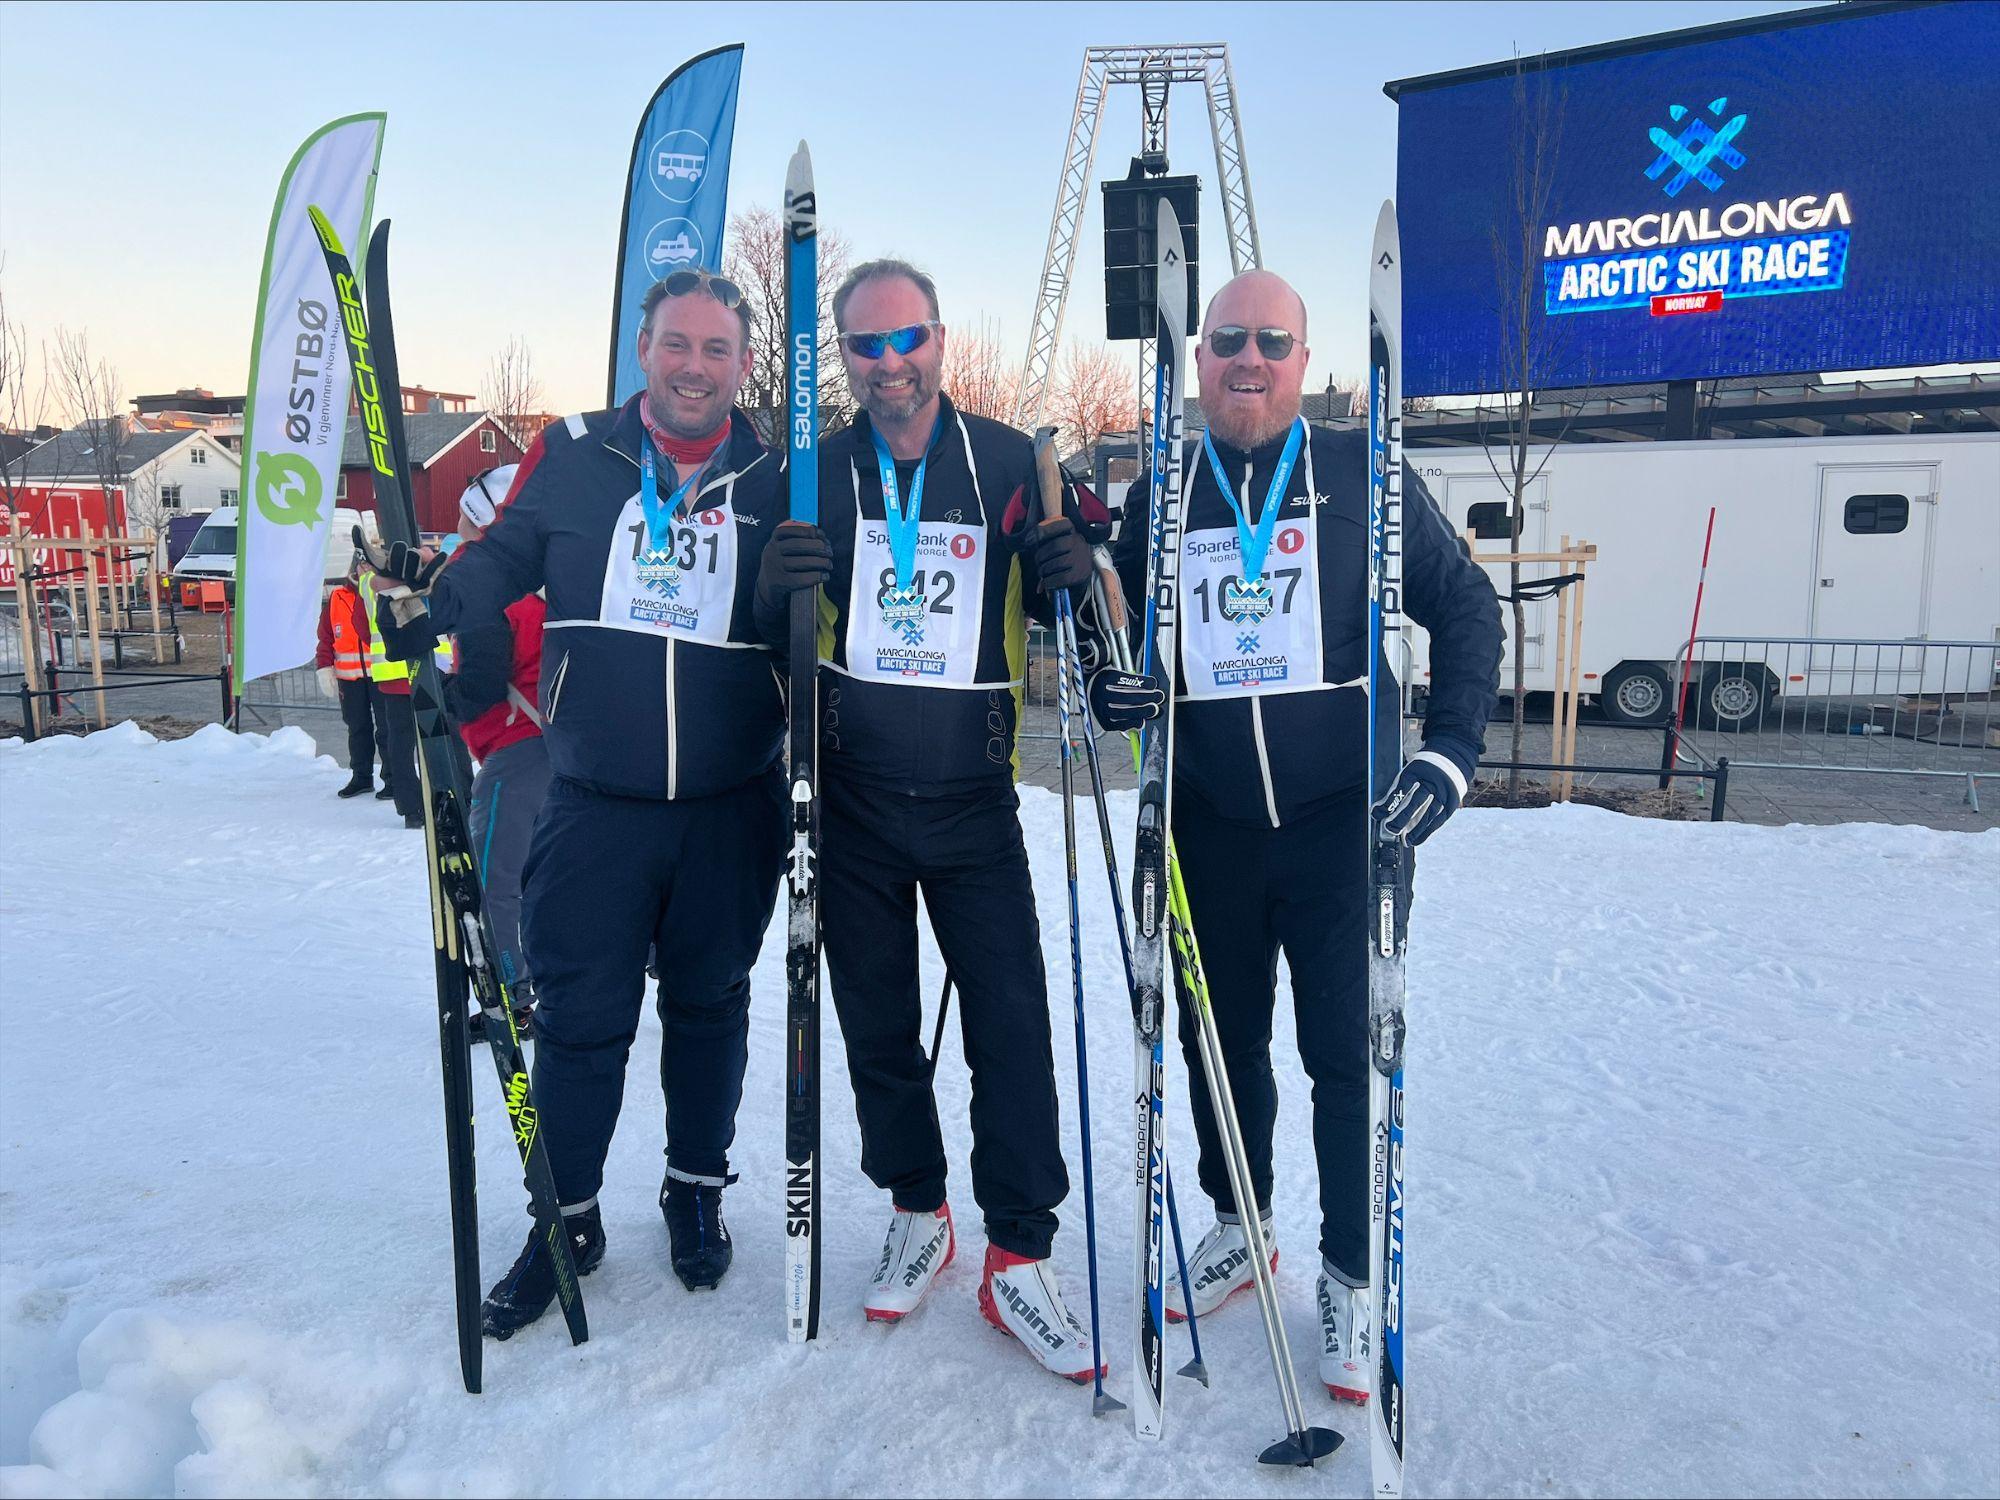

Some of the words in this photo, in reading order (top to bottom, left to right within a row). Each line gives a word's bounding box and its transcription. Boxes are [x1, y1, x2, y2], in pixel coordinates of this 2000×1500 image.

[1544, 192, 1851, 257] MARCIALONGA
[1558, 256, 1668, 301] ARCTIC
[1676, 248, 1729, 292] SKI
[1741, 239, 1830, 283] RACE
[1665, 296, 1708, 311] NORWAY
[325, 311, 341, 370] Nord-Nor
[285, 298, 328, 445] ØSTBØ
[336, 272, 395, 477] FISCHER
[631, 597, 699, 617] MARCIALONGA
[633, 608, 660, 621] ARCTIC
[661, 612, 675, 622] SKI
[676, 614, 695, 626] RACE
[1193, 567, 1302, 623] 107
[876, 647, 946, 661] MARCIALONGA
[880, 658, 905, 669] ARCTIC
[908, 659, 921, 671] SKI
[922, 660, 942, 672] RACE
[1212, 655, 1288, 671] MARCIALONGA
[1218, 671, 1246, 682] ARCTIC
[1247, 669, 1260, 680] SKI
[1263, 667, 1284, 678] RACE
[787, 1168, 811, 1239] SKIN
[902, 1221, 947, 1288] alpina
[996, 1279, 1065, 1350] alpina
